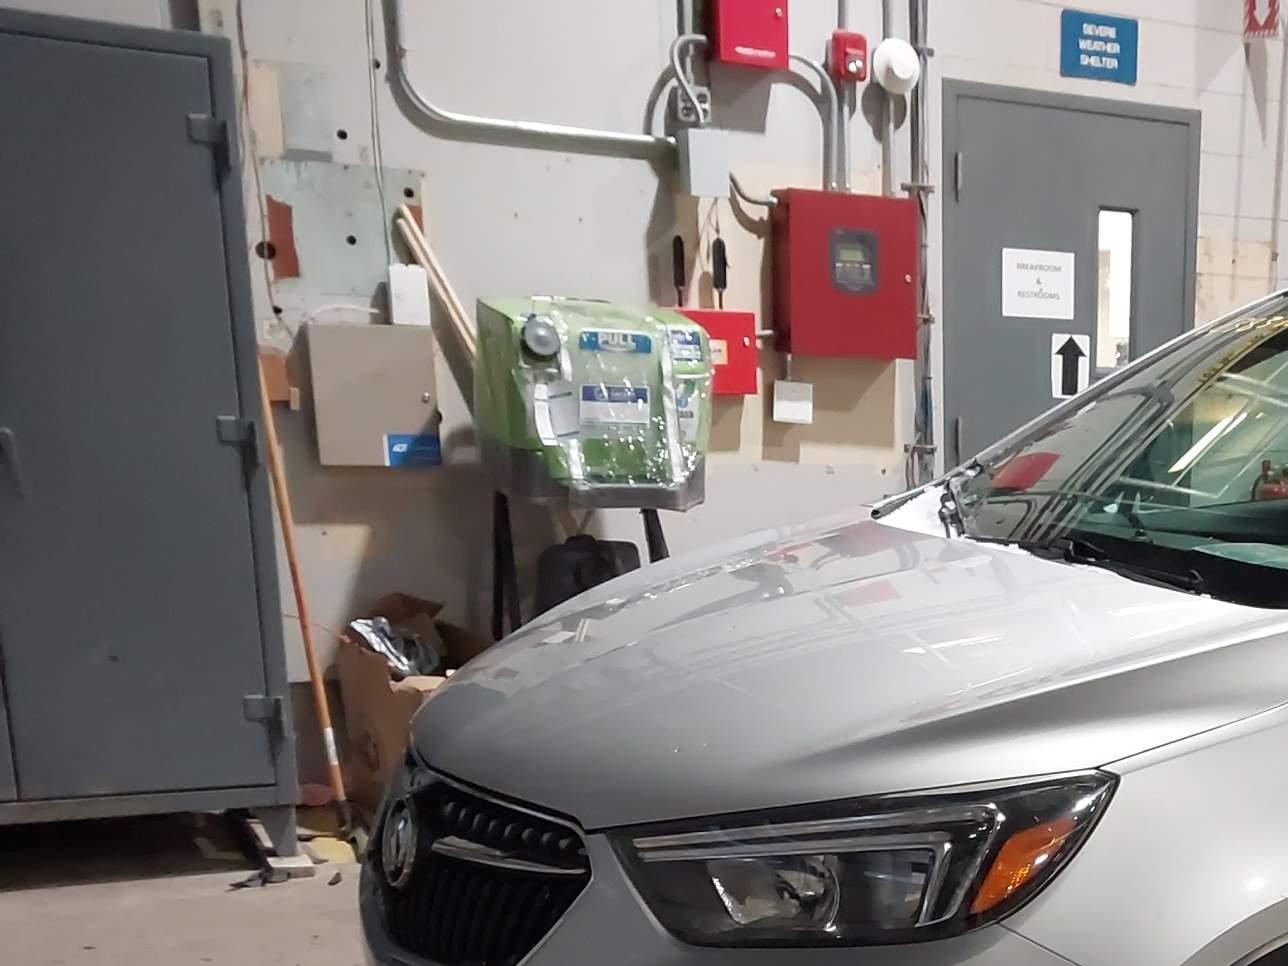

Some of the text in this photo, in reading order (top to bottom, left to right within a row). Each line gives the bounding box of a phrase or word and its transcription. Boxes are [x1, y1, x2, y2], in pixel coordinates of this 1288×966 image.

[1082, 23, 1117, 39] SEVERE
[1078, 38, 1121, 54] WEATHER
[1080, 54, 1119, 69] SHELTER
[1016, 262, 1062, 272] BREAKROOM
[1017, 290, 1061, 300] RESTROOMS
[598, 331, 636, 346] PULL
